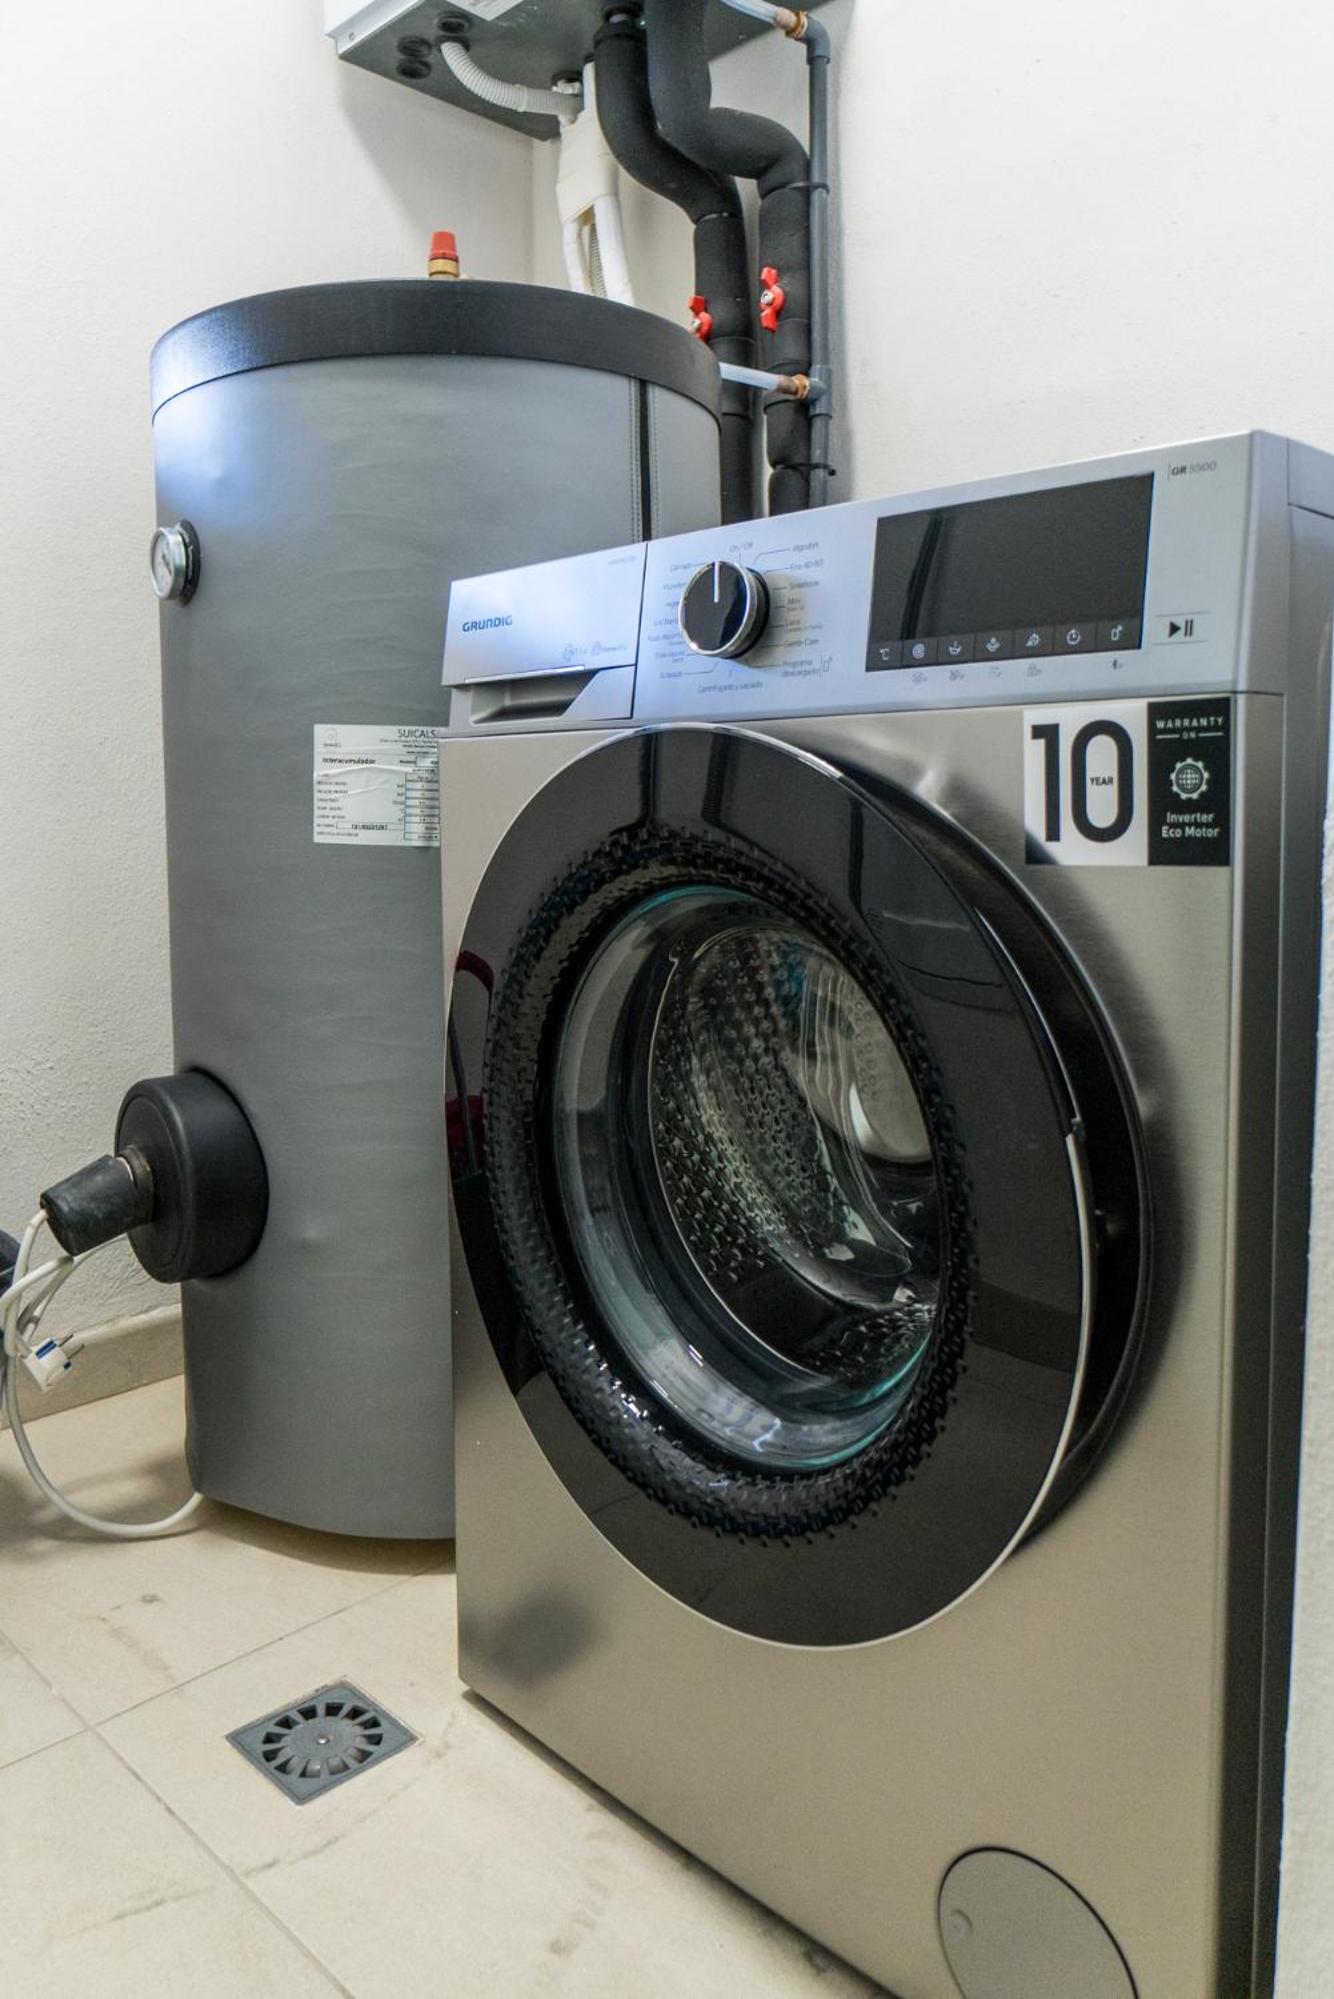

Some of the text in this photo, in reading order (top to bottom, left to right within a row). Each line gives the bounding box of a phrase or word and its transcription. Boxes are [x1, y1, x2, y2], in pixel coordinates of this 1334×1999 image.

[462, 615, 513, 632] GRUNDIG
[1155, 716, 1224, 730] WARRANTY
[1031, 719, 1133, 842] 10
[1090, 776, 1114, 787] YEAR
[1166, 811, 1215, 823] Inverter
[1161, 825, 1220, 838] Eco Motor
